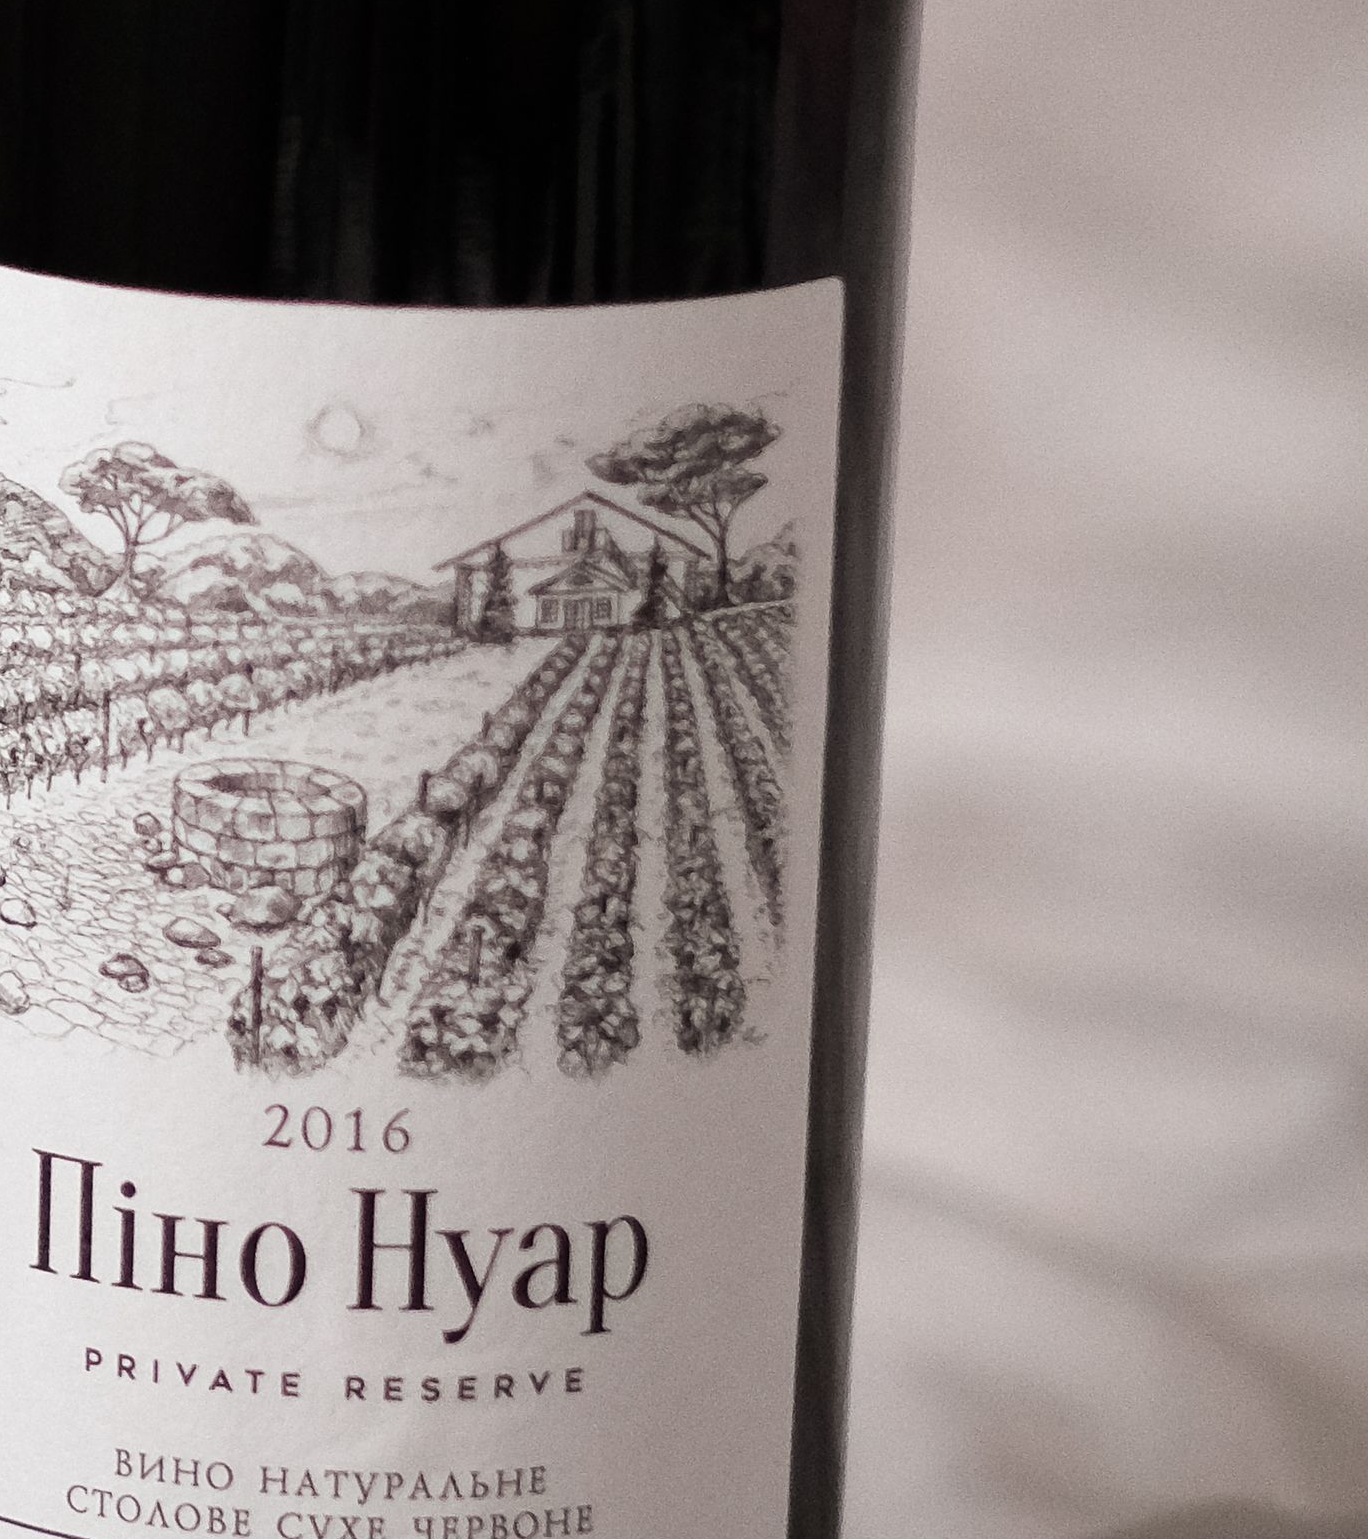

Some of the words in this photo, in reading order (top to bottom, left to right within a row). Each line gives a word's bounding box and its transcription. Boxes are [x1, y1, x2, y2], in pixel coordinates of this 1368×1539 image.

[261, 1102, 412, 1156] 2016
[28, 1146, 309, 1309] Піно
[348, 1187, 650, 1346] Нуар
[83, 1346, 302, 1399] PRIVATE
[343, 1366, 585, 1405] RESERVE
[113, 1448, 236, 1491] ВИНО
[258, 1464, 547, 1507] НАТУРАЛЬНЕ
[65, 1483, 252, 1539] СТОЛОВЕ
